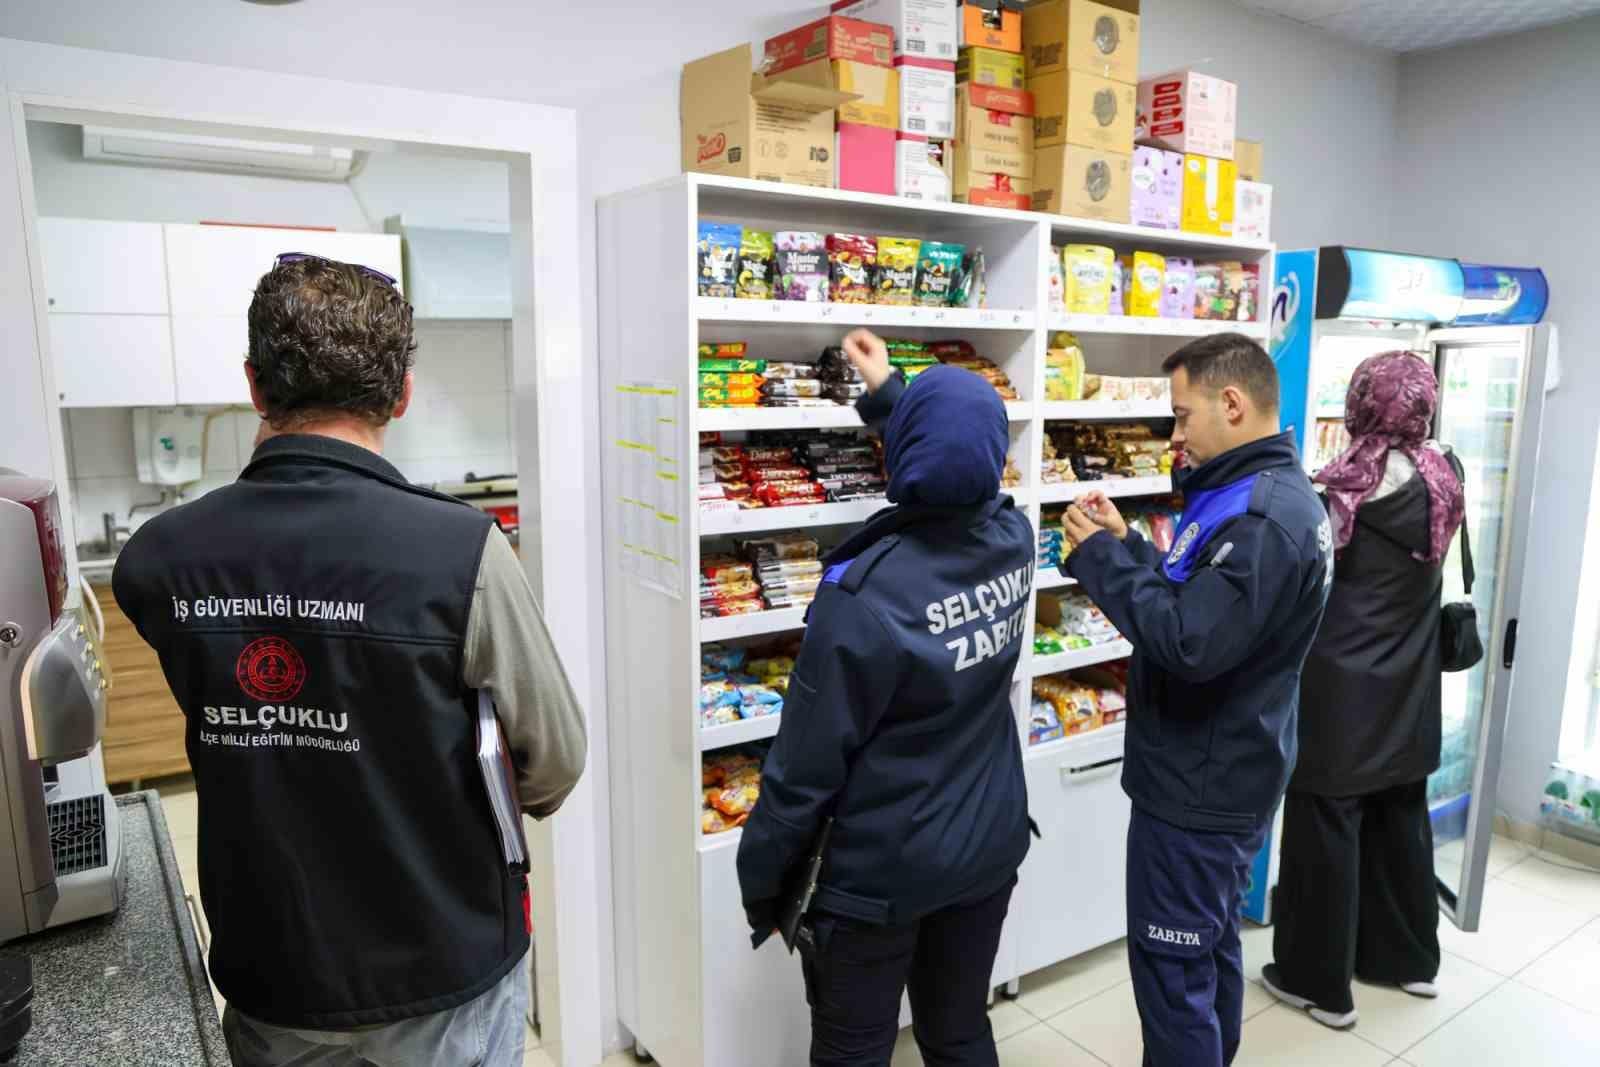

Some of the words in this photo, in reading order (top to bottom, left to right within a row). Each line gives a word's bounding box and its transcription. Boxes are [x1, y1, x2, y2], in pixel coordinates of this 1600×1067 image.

[171, 595, 189, 623] İŞ
[194, 594, 292, 618] GÜVENLİĞİ
[297, 599, 365, 622] UZMANI
[203, 705, 349, 733] SELÇUKLU
[200, 729, 220, 746] LÇE
[221, 731, 250, 748] MİLLİ
[251, 731, 293, 748] EĞİTİM
[1147, 924, 1201, 946] ZABITA
